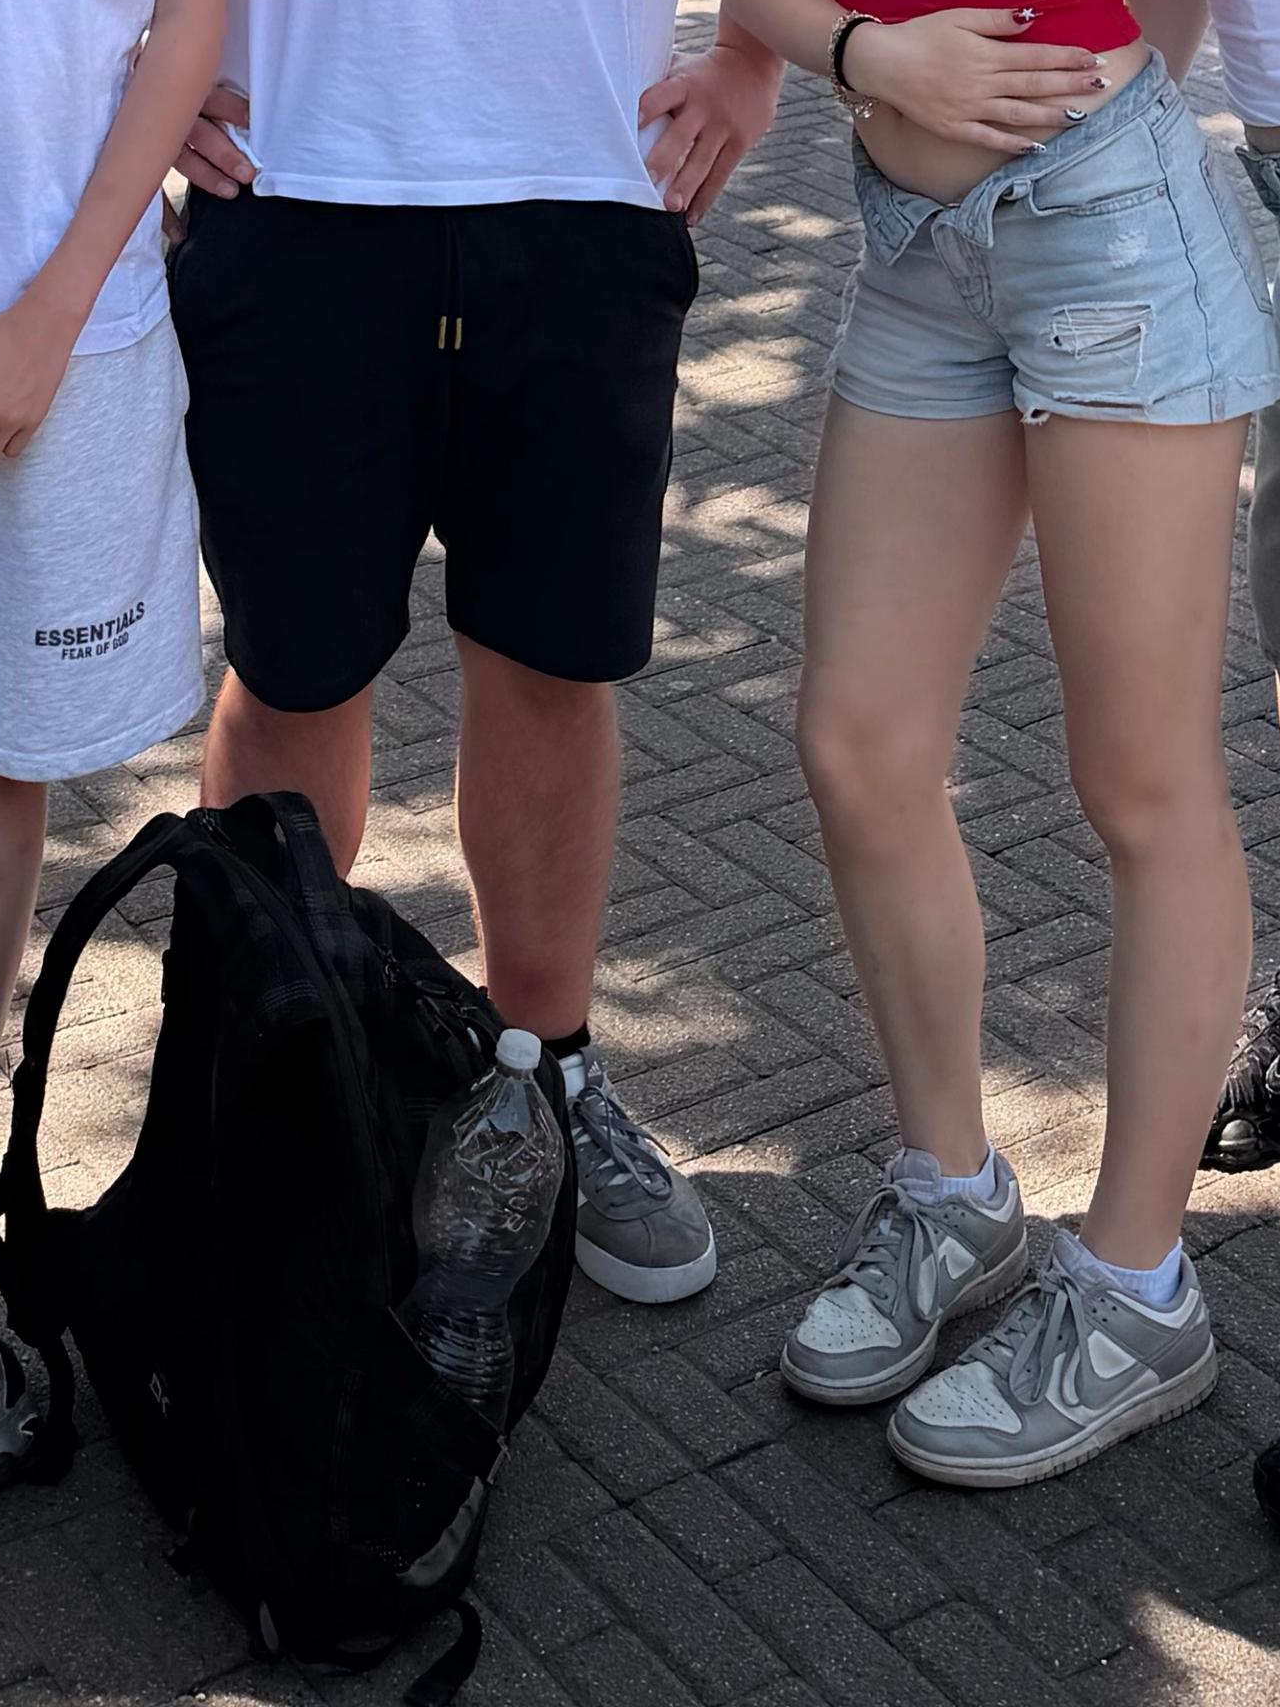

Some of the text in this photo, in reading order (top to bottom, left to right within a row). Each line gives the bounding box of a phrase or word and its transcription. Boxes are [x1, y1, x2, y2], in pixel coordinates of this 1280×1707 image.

[35, 601, 145, 647] ESSENTIALS
[61, 631, 129, 660] FEAR OF GOD
